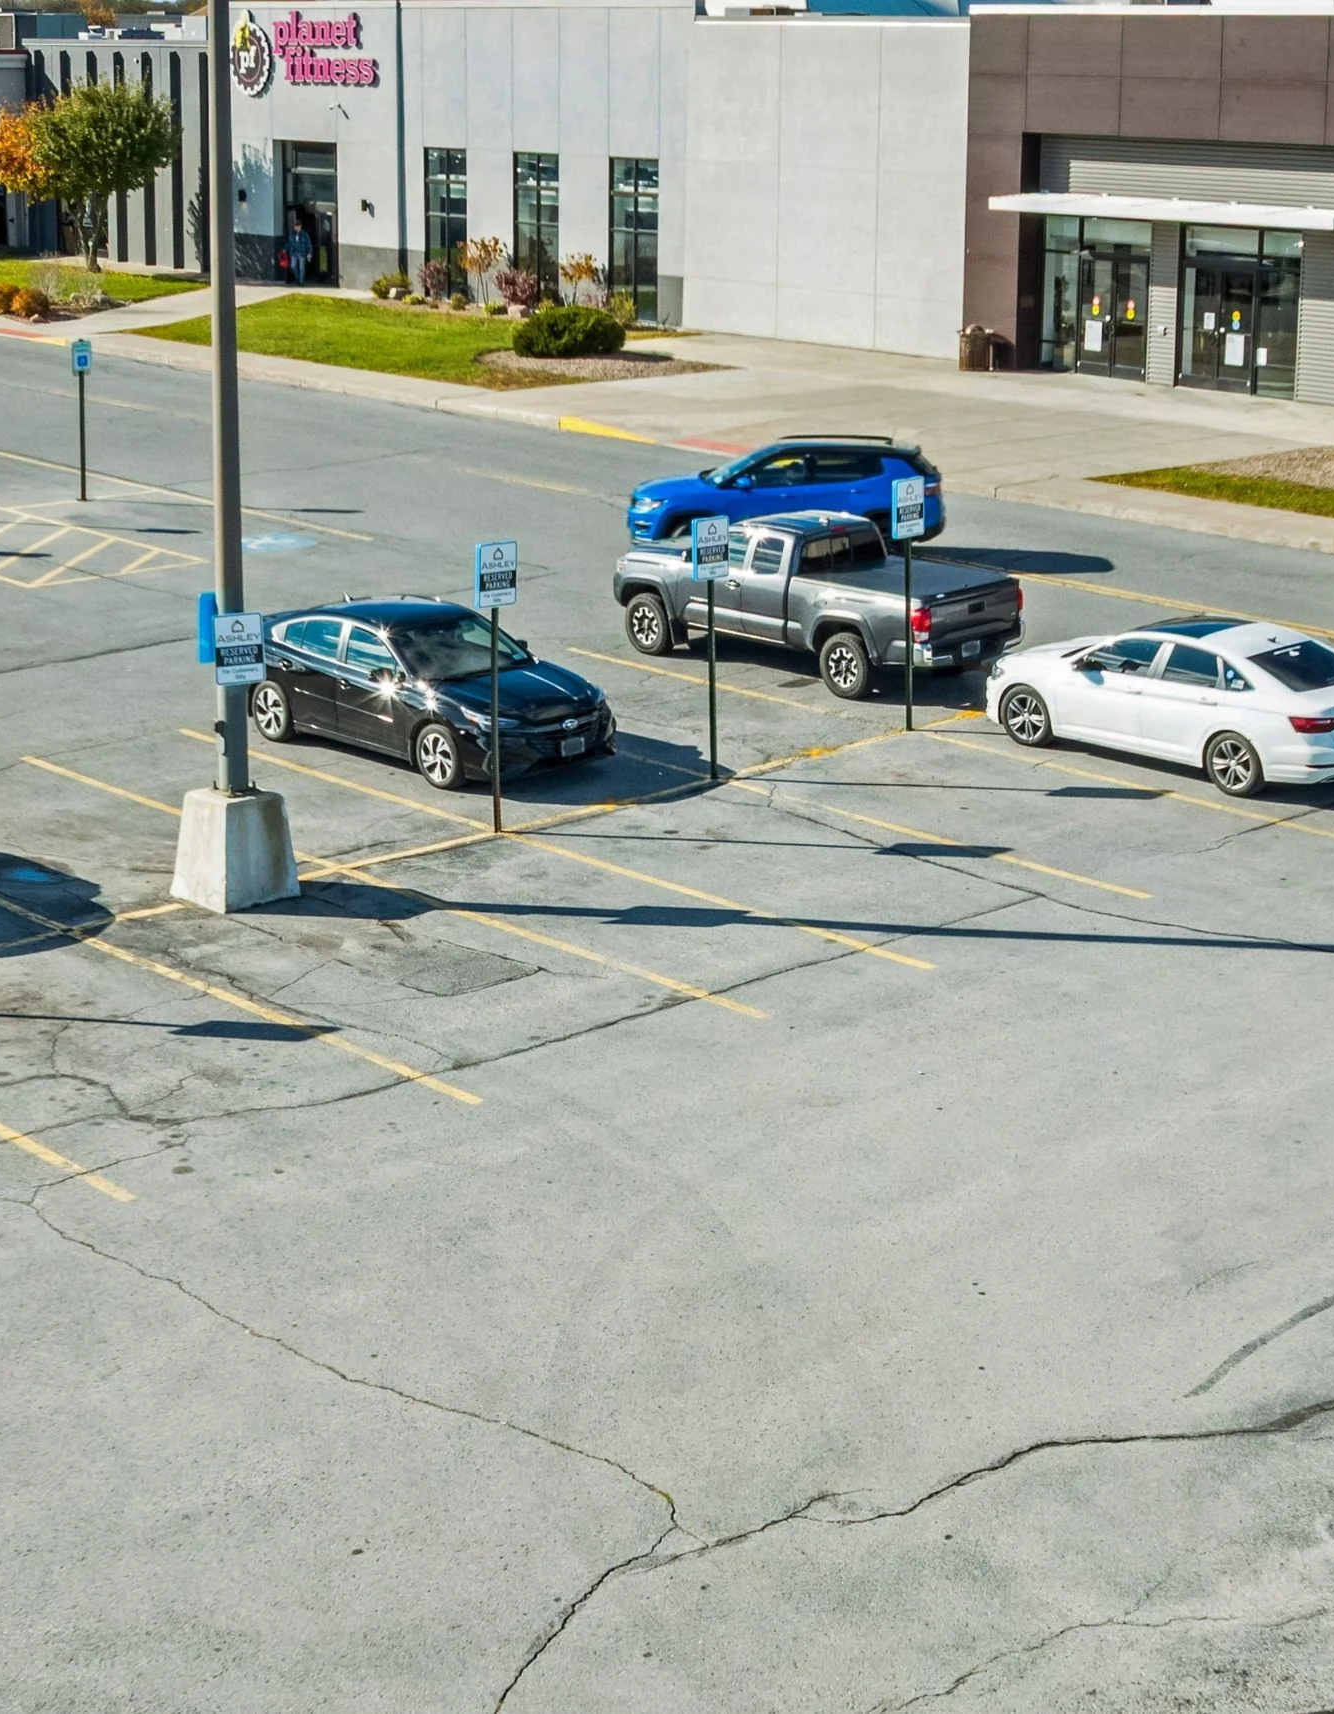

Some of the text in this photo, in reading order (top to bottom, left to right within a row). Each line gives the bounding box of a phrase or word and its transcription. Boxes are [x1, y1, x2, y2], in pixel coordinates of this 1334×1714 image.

[272, 10, 356, 55] planet
[239, 45, 257, 74] pf
[284, 46, 374, 84] fitness
[698, 535, 727, 544] ASHLEY
[481, 560, 515, 571] ASHLEY
[483, 571, 513, 583] RESERVED
[485, 580, 511, 591] PARKING
[217, 632, 261, 643] ASHLEY
[220, 645, 259, 657] RESERVED
[223, 655, 257, 666] PARKING
